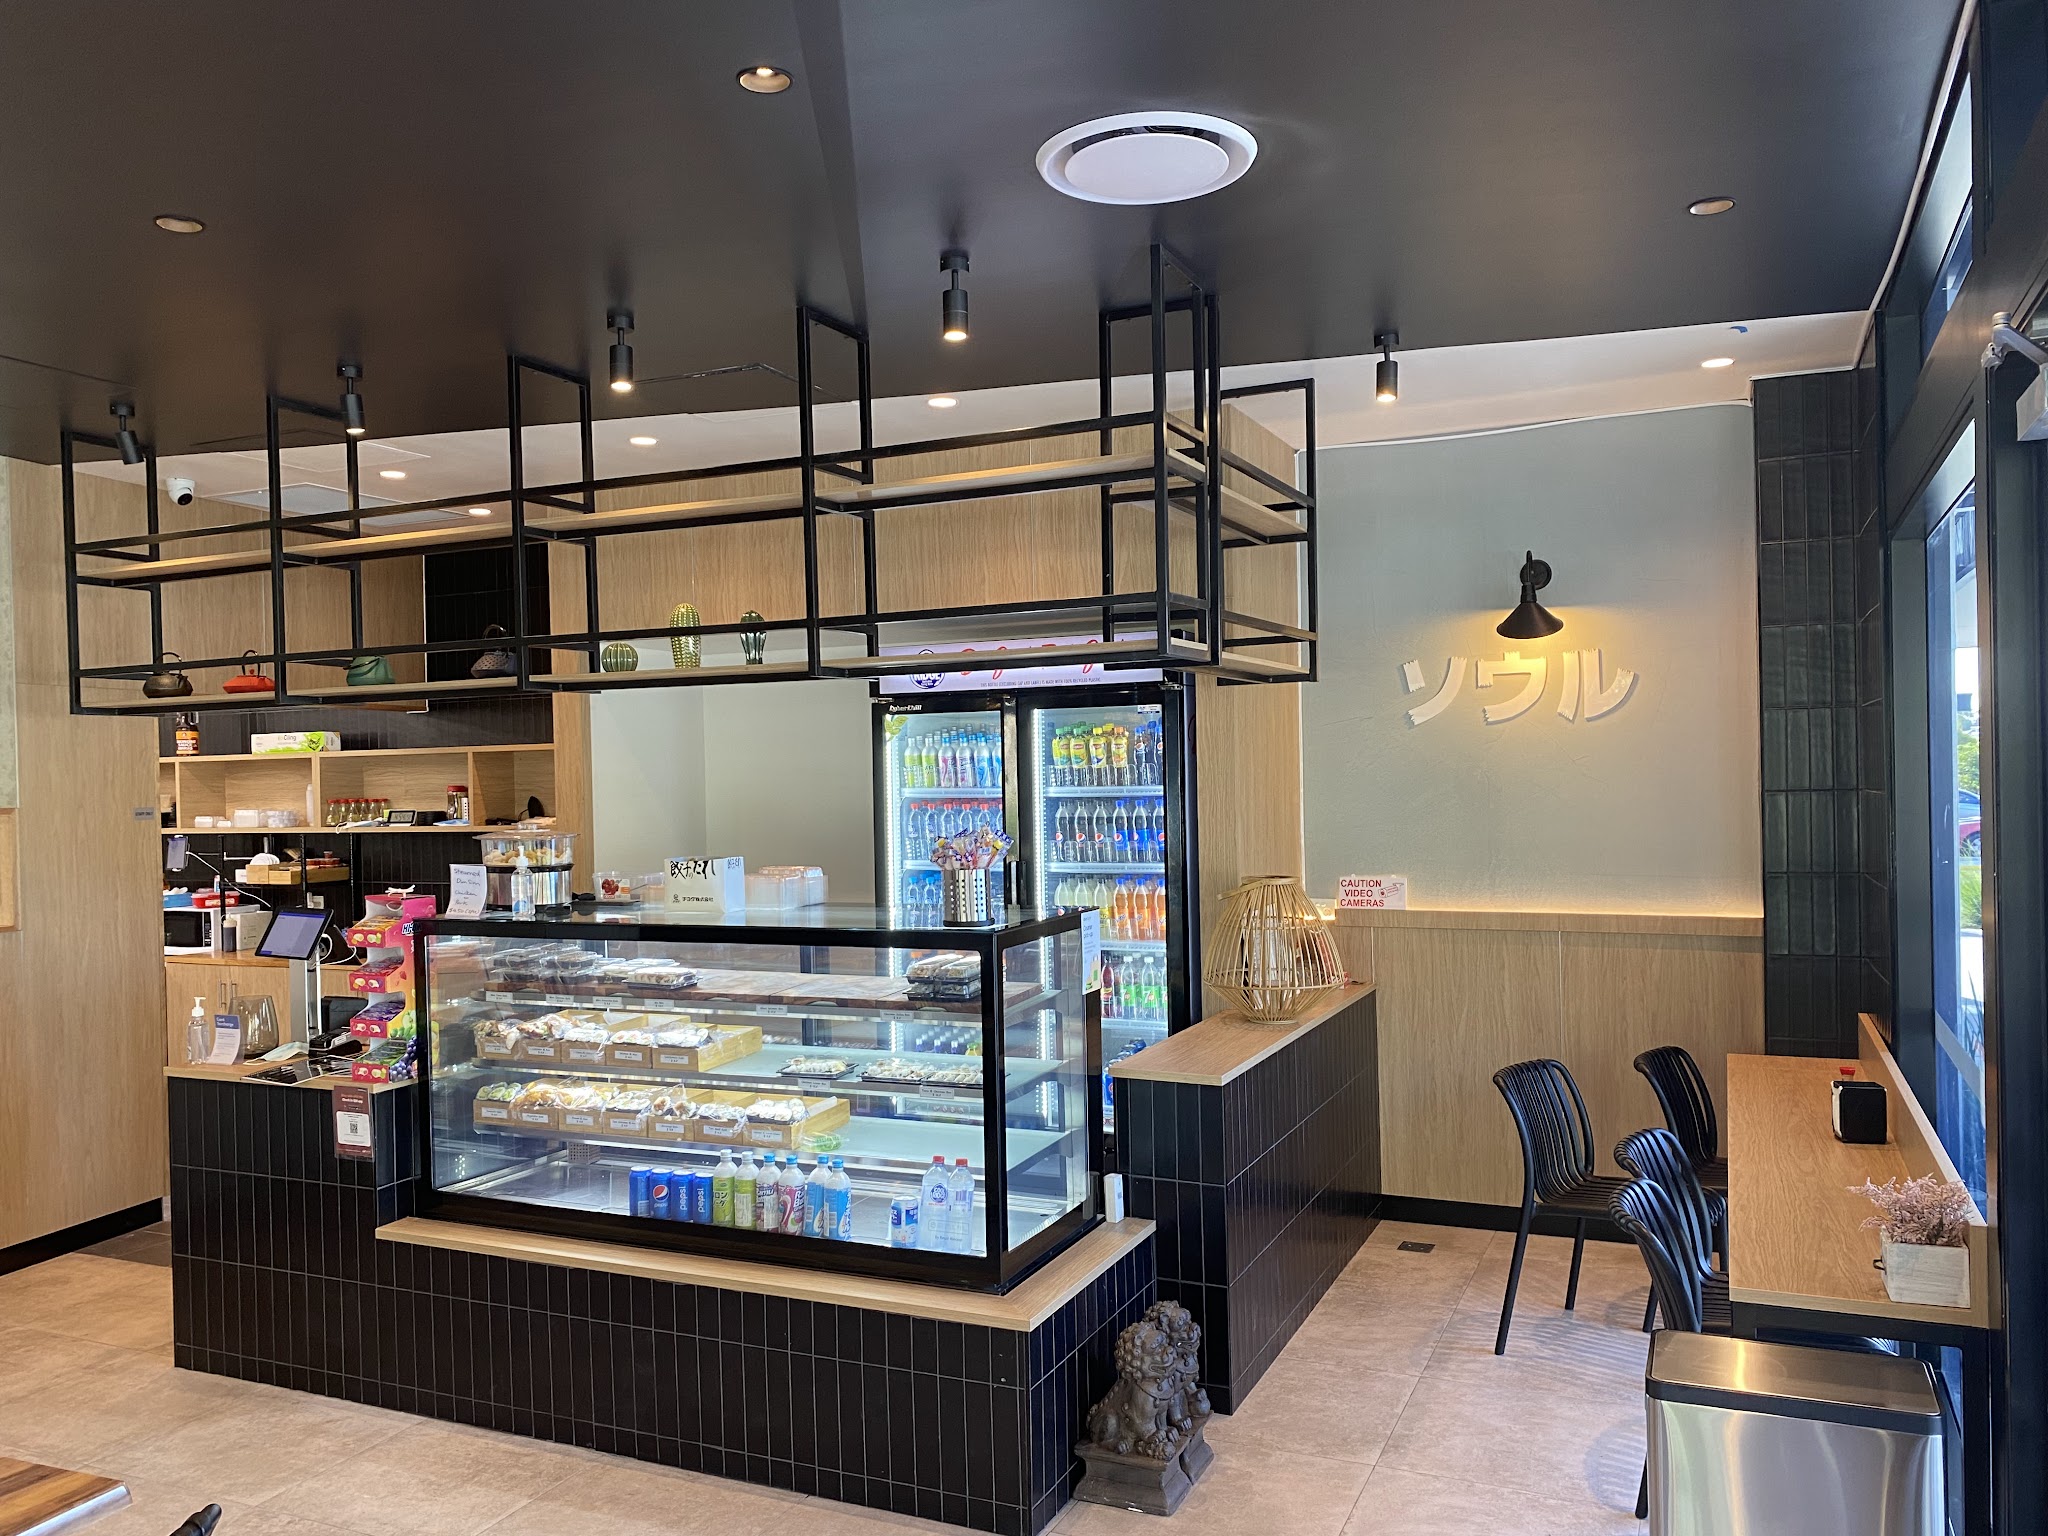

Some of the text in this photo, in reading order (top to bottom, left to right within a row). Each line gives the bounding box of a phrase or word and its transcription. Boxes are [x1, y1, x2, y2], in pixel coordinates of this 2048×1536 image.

[1402, 647, 1635, 726] ソウル
[1340, 879, 1382, 887] CAUTION
[1344, 889, 1373, 898] VIDEO
[1340, 899, 1385, 907] CAMERAS
[678, 1185, 687, 1211] pepsi
[696, 1187, 705, 1213] pepsi
